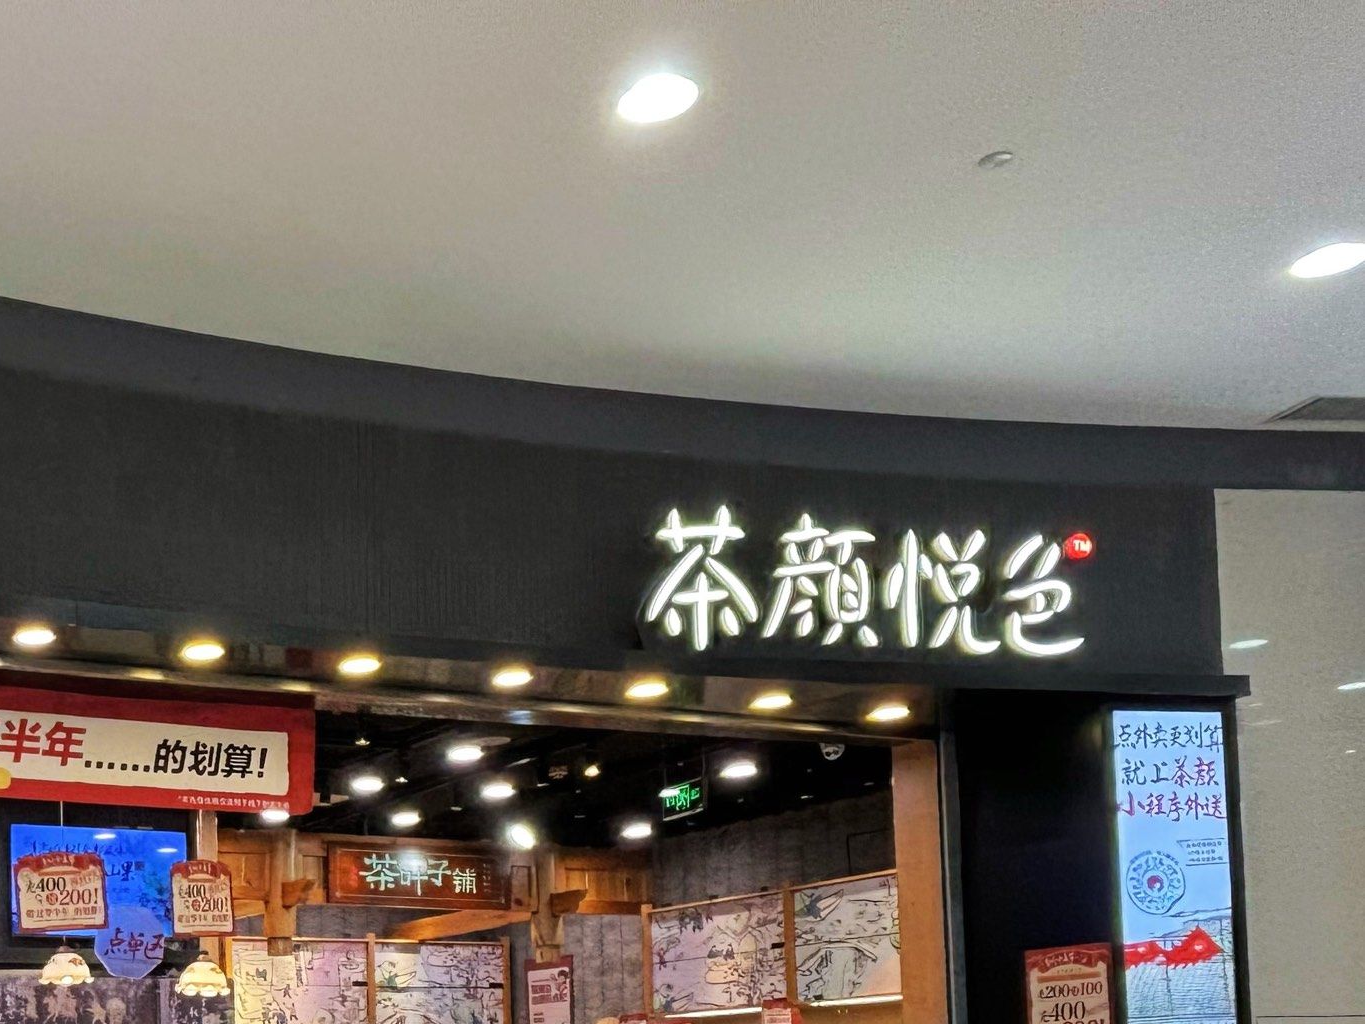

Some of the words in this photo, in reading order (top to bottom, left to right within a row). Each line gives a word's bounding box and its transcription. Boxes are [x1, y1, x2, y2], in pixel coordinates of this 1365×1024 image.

[645, 504, 1085, 657] 茶颜悦色
[1115, 721, 1224, 753] 点外卖更划算
[1115, 791, 1227, 822] 小程序外送
[359, 853, 477, 896] 茶叶子铺
